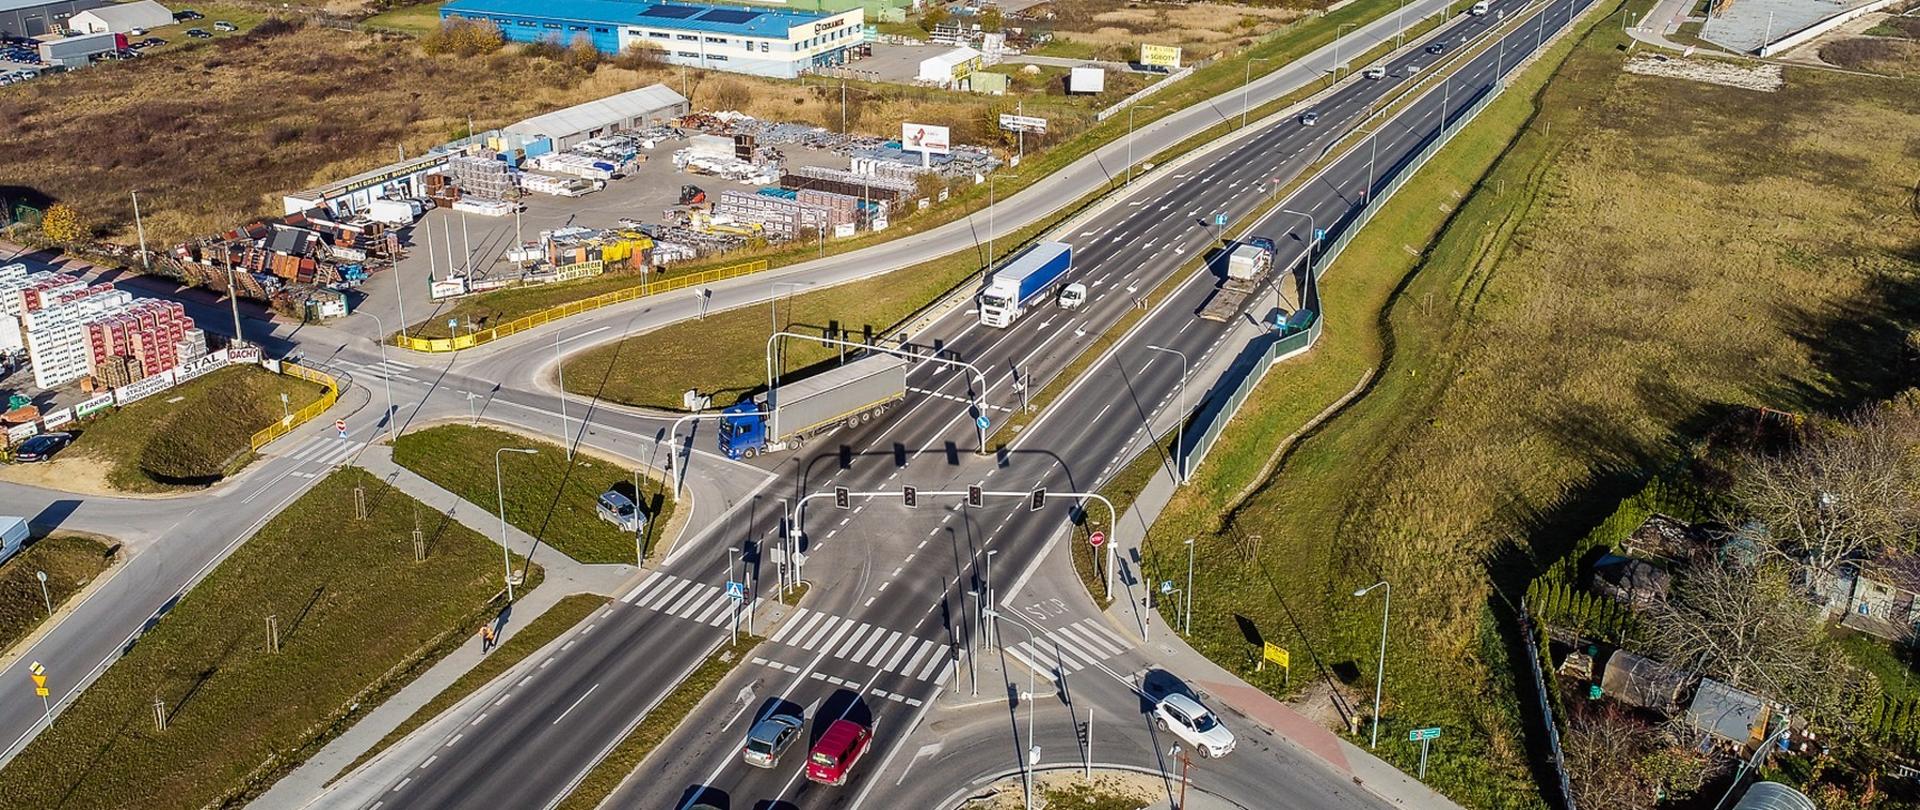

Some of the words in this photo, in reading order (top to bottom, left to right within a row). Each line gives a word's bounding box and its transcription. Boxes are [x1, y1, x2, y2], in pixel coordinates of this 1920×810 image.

[229, 348, 258, 360] DACHY
[183, 354, 220, 374] STAL
[85, 395, 111, 410] FAKRO
[1025, 598, 1070, 620] STOP
